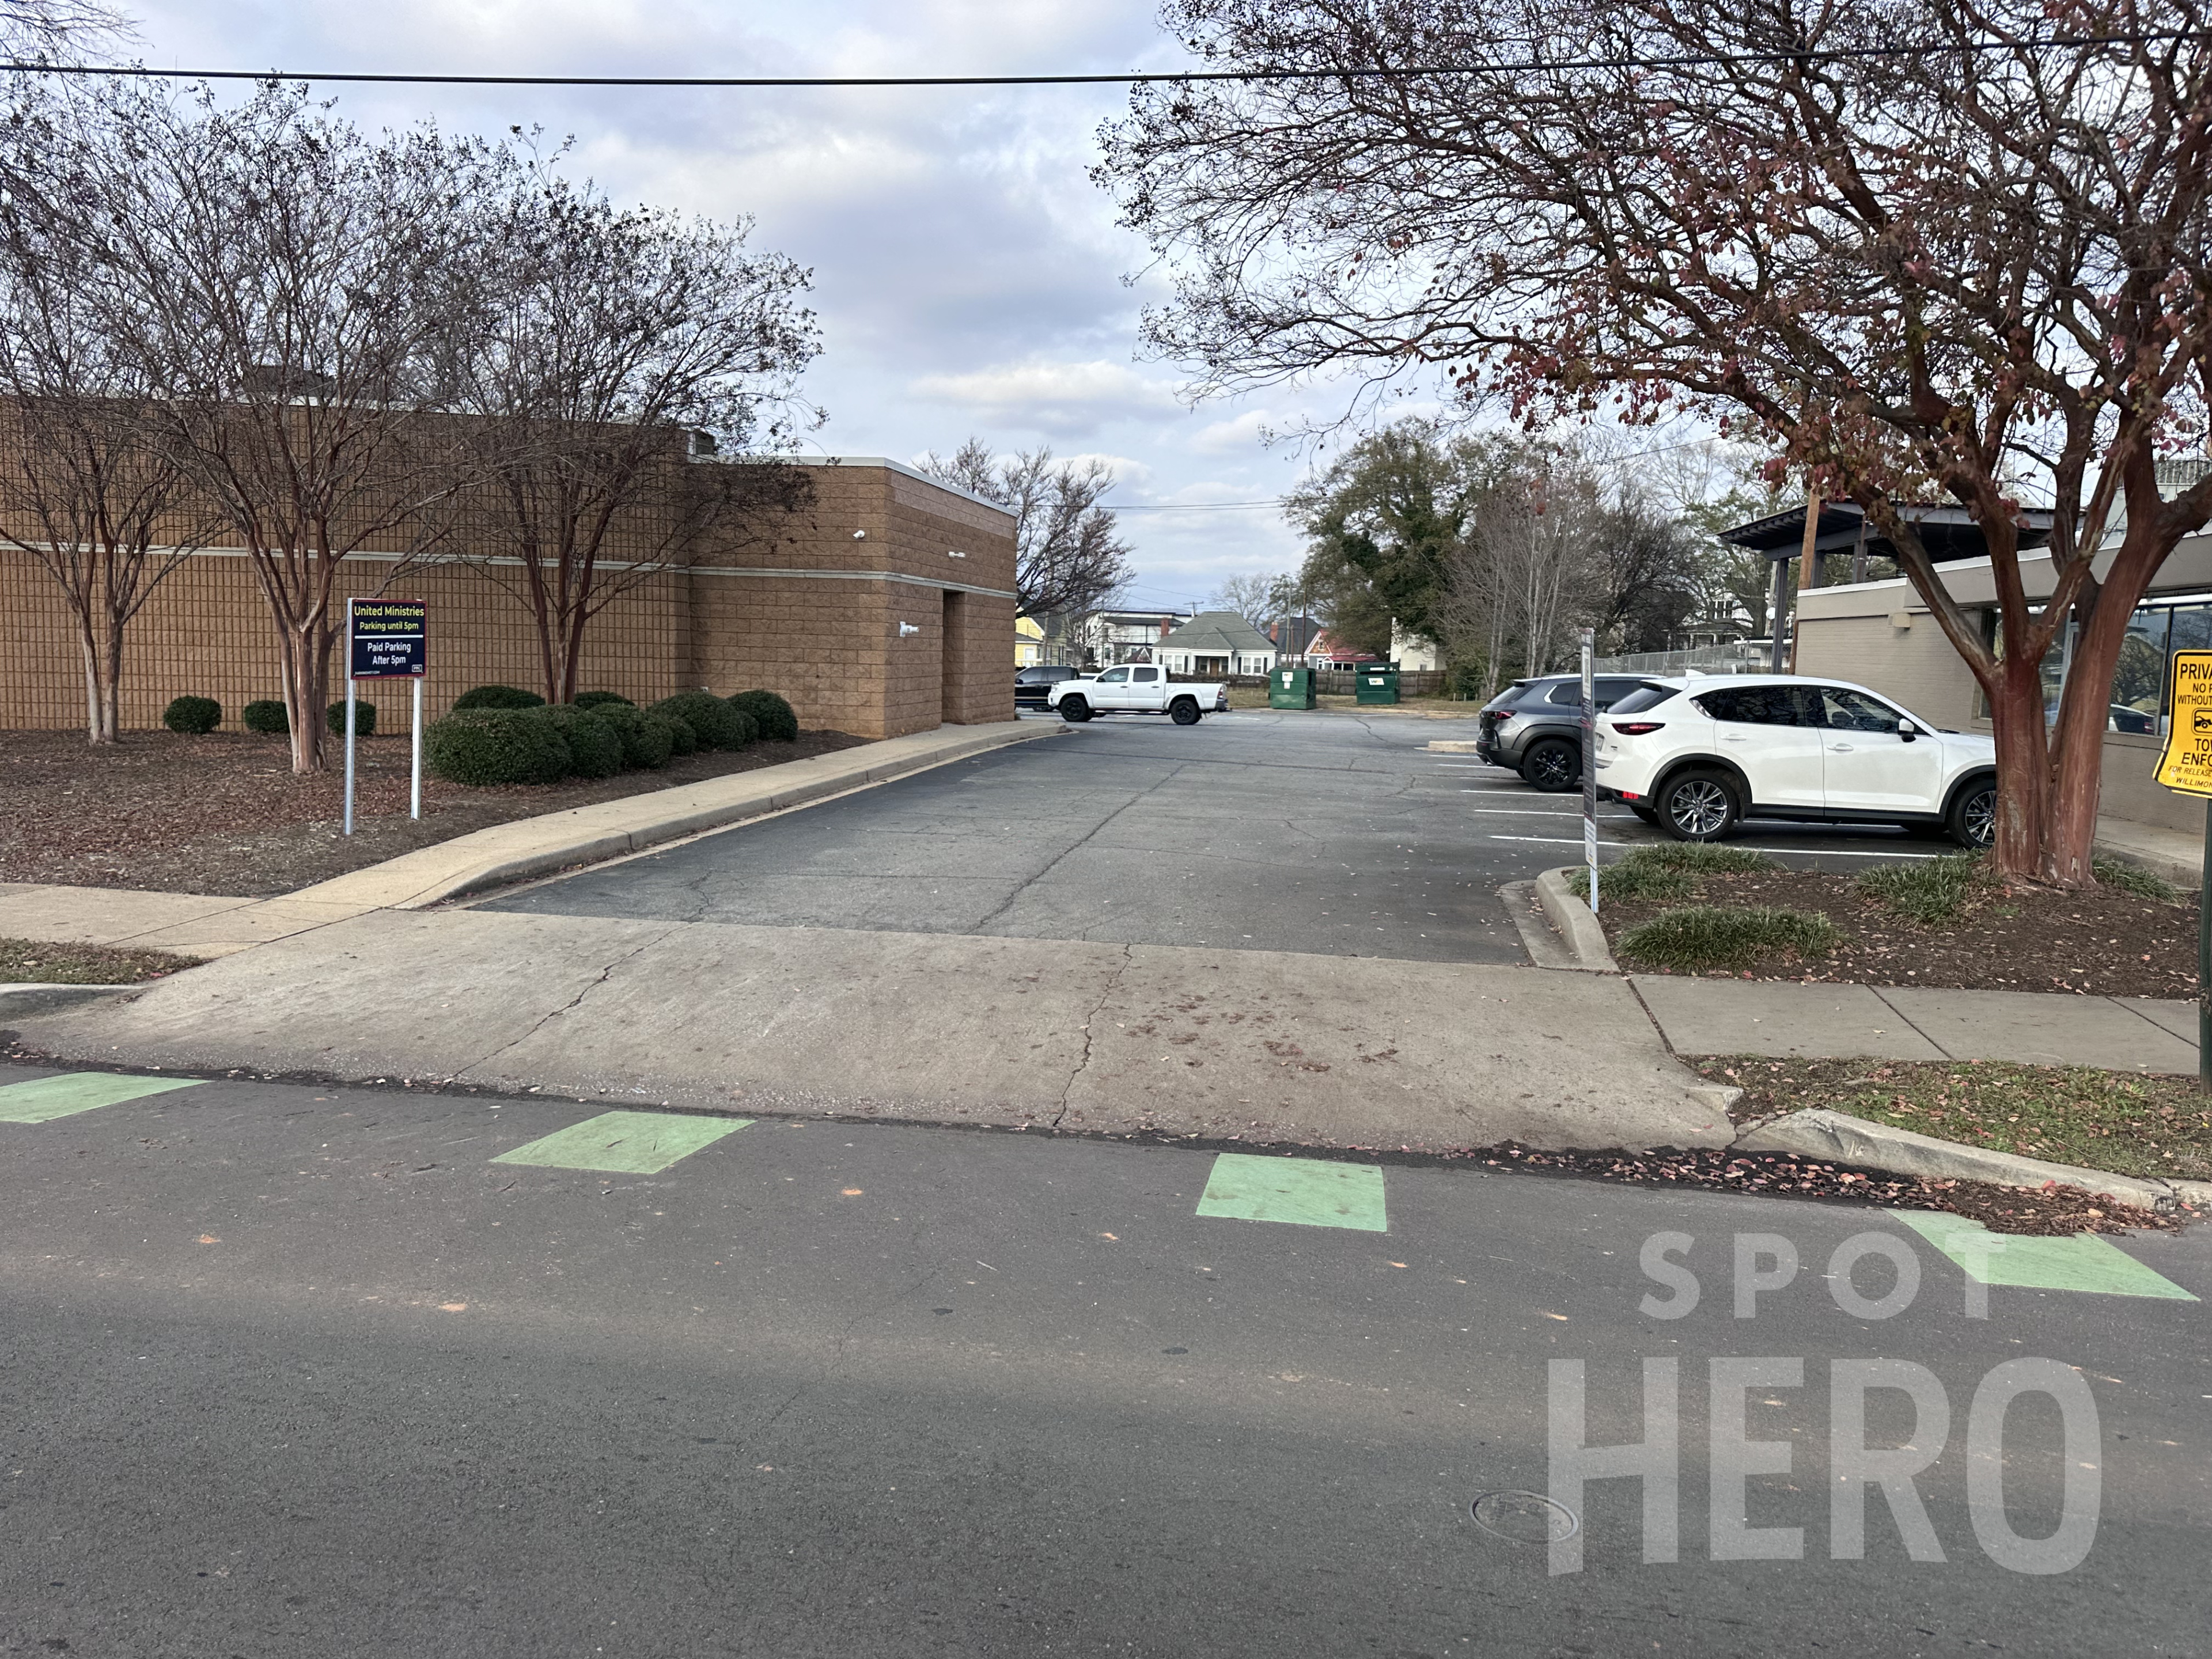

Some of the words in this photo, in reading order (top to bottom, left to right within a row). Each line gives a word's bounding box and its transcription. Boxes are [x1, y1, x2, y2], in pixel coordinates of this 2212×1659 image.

[354, 605, 382, 616] United
[385, 605, 425, 616] Ministries
[359, 621, 386, 631] Parking
[388, 621, 403, 630] until
[404, 622, 419, 631] 5pm
[368, 642, 383, 652] Paid
[385, 642, 411, 653] Parking
[372, 656, 389, 665] After
[391, 655, 406, 666] 5pm
[2192, 683, 2206, 693] NO
[2177, 694, 2212, 706] WITHOUT
[2195, 738, 2212, 752] TO
[2184, 767, 2211, 777] RELEASE
